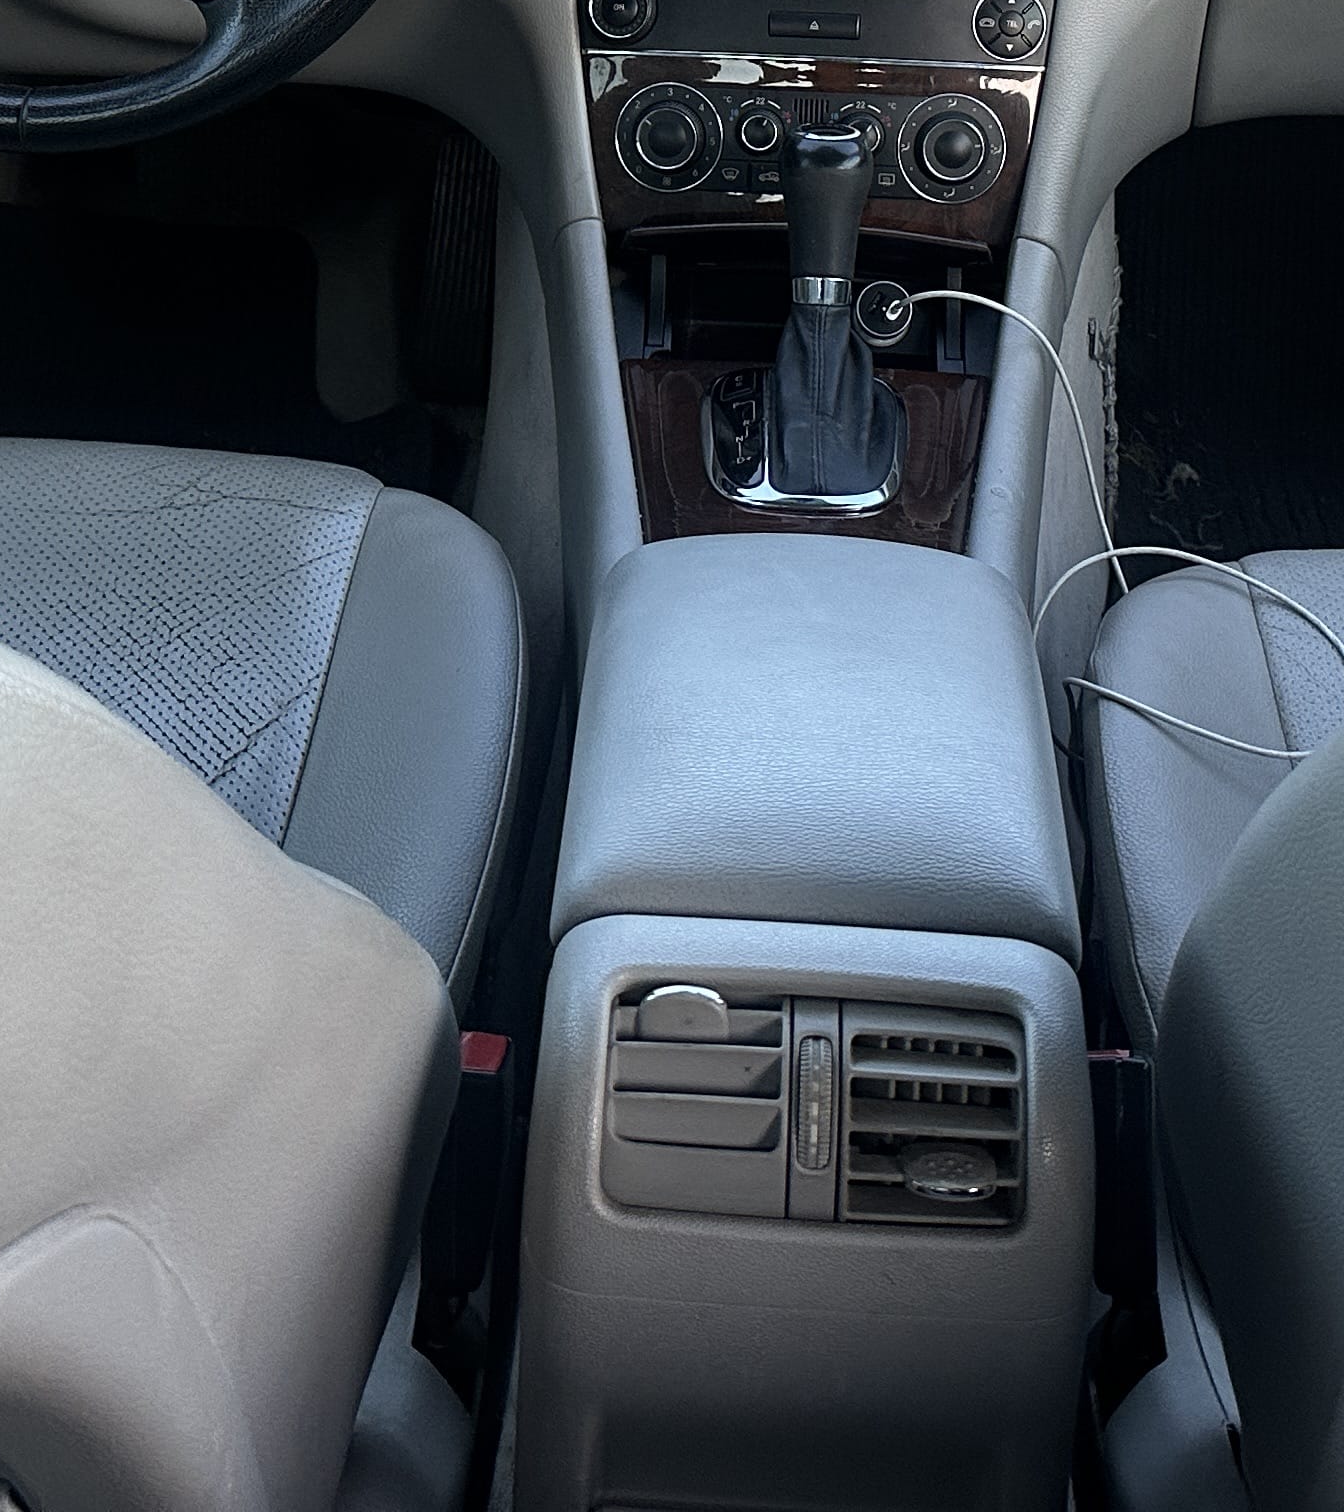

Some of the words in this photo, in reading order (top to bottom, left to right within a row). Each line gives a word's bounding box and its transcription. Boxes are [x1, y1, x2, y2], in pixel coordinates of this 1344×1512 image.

[1006, 19, 1018, 29] TEL
[666, 88, 674, 97] 3
[635, 100, 642, 109] 2
[755, 97, 766, 105] 22
[855, 100, 866, 109] 22
[698, 103, 705, 112] 4
[736, 435, 744, 443] N
